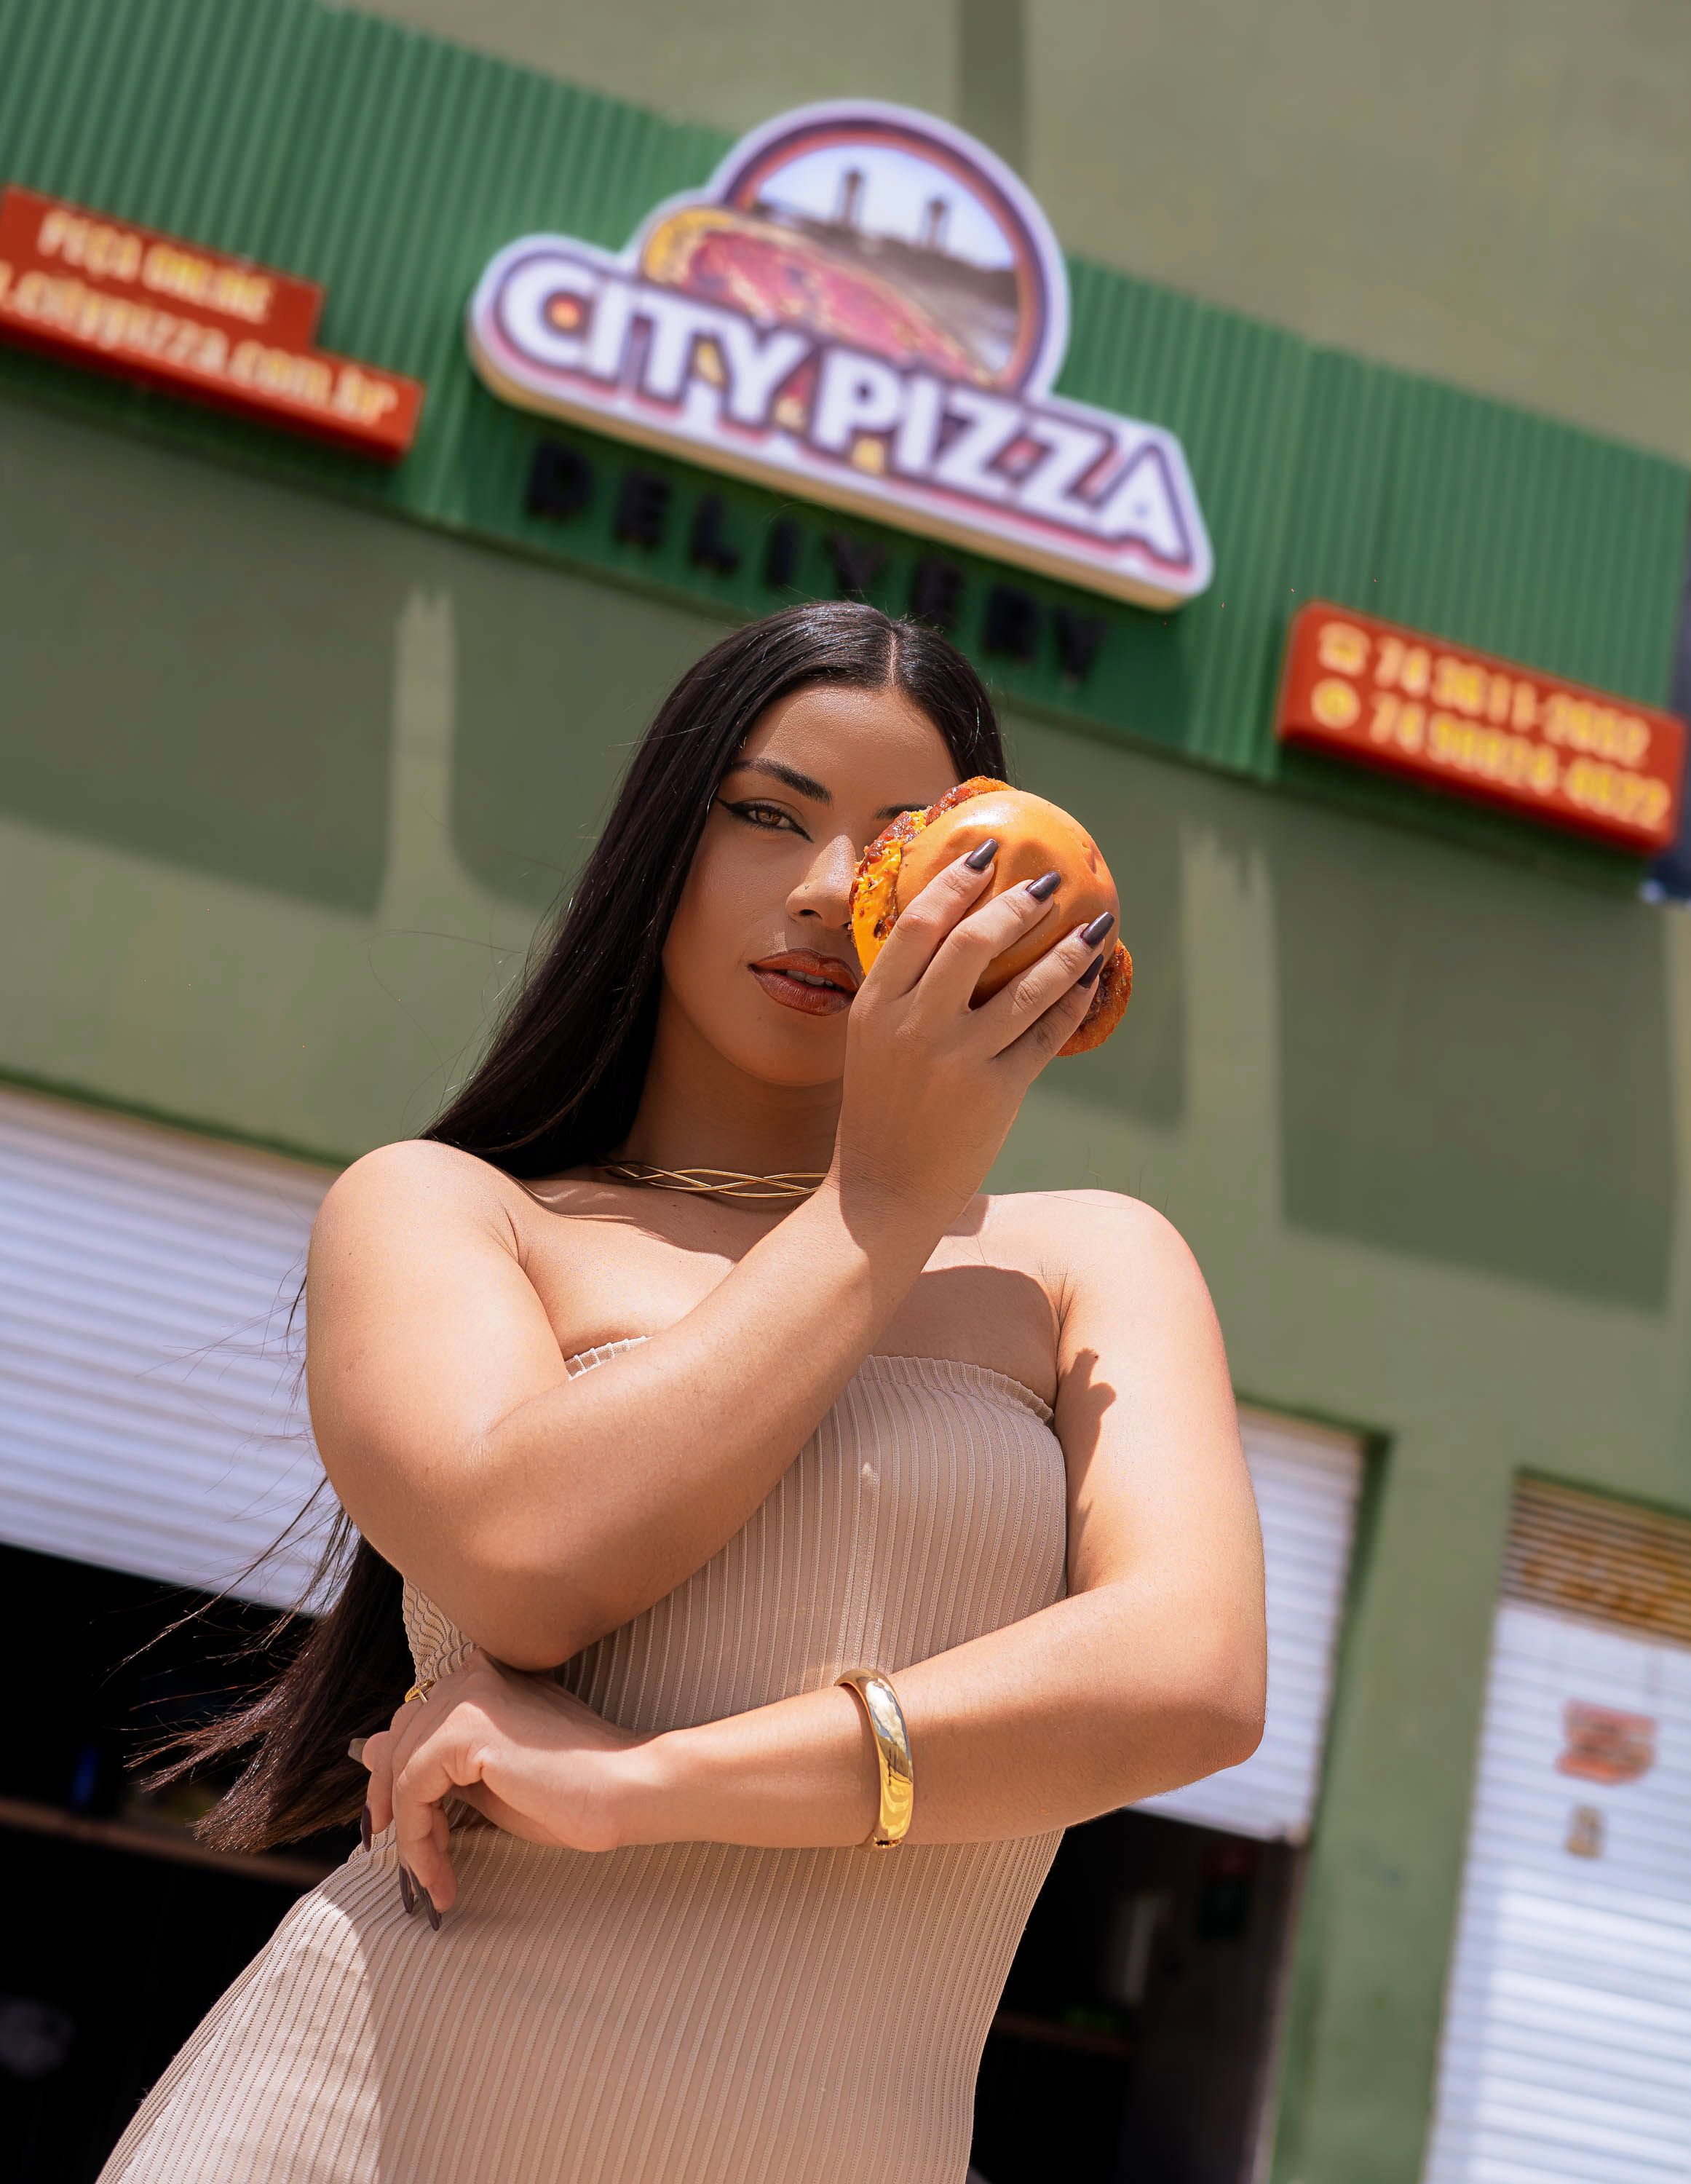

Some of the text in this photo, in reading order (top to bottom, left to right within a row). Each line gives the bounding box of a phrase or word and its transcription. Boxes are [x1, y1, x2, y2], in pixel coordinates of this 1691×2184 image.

[143, 242, 273, 325] ONLINE
[497, 255, 1195, 571] CITY PIZZA
[523, 441, 1110, 683] DELIVERY
